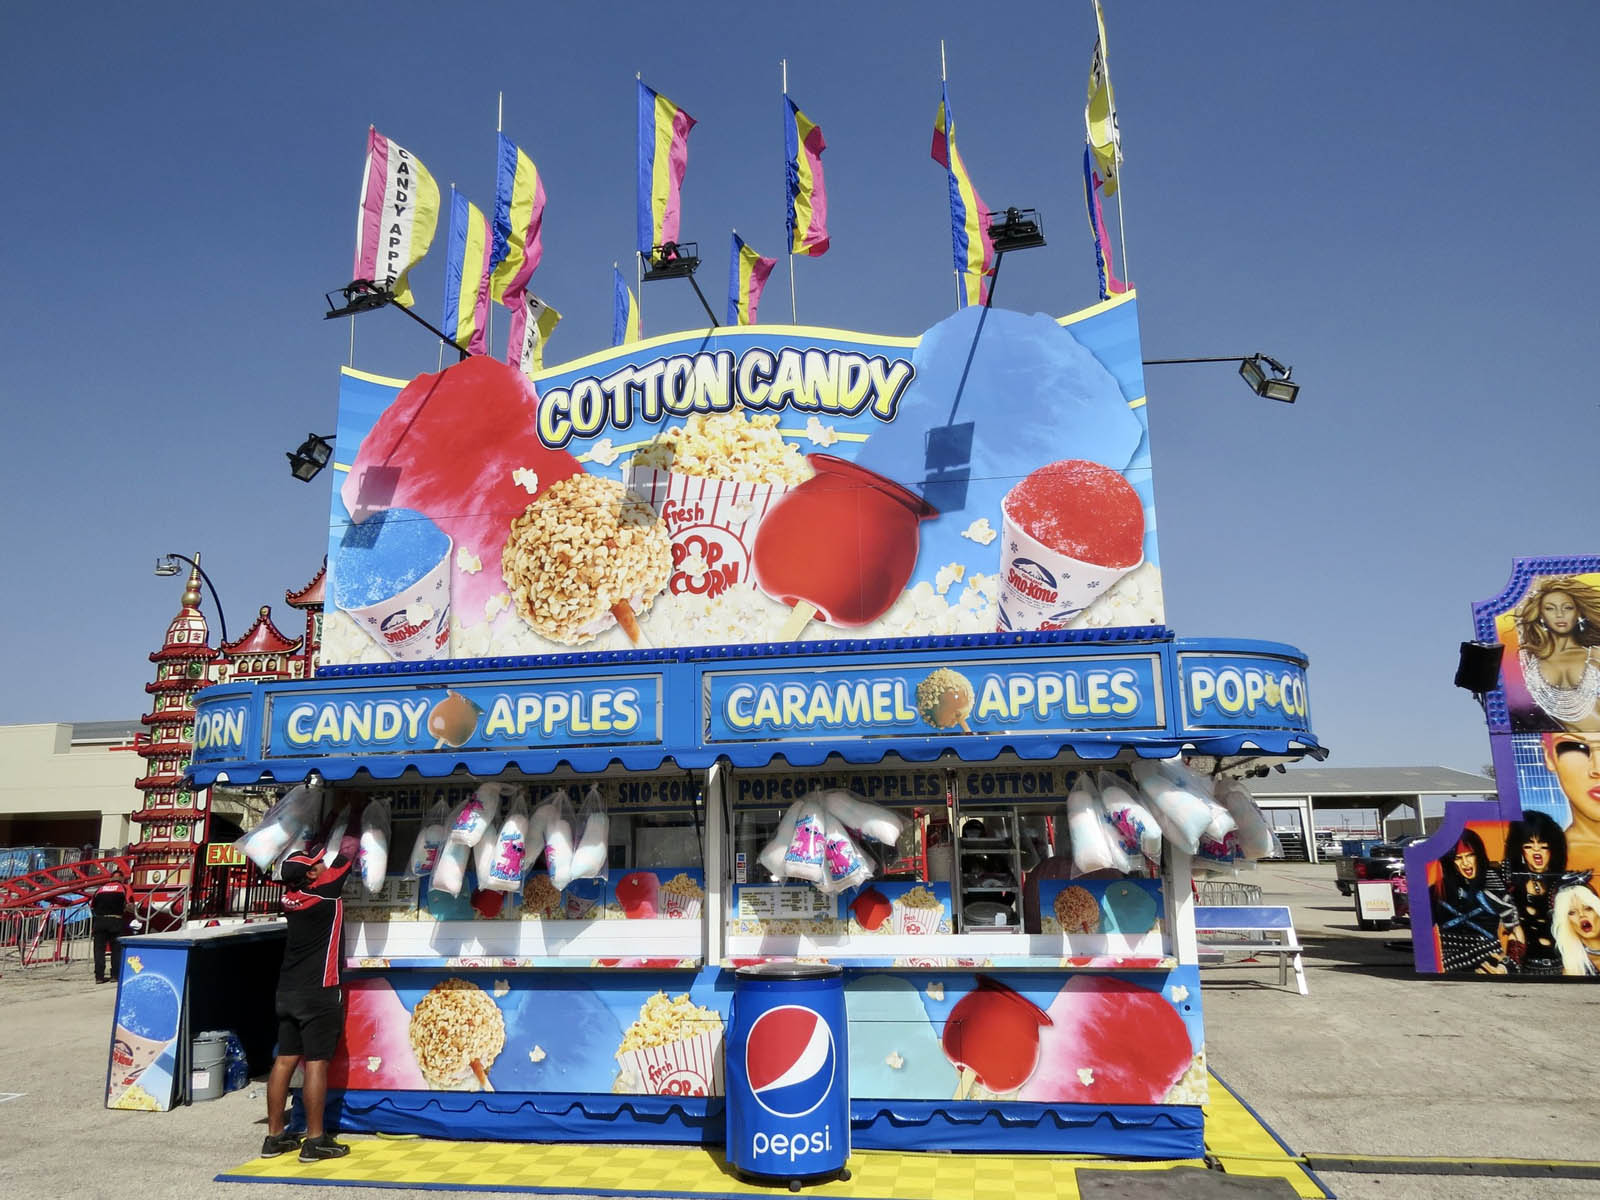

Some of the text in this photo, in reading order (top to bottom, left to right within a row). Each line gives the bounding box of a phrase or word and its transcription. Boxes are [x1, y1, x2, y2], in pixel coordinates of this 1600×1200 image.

[393, 149, 410, 217] CANDY
[537, 349, 911, 446] COTTON CANDY
[662, 500, 704, 533] fresh
[671, 535, 723, 571] POP
[670, 562, 739, 599] CORN
[287, 692, 638, 743] CANDY APPLES
[727, 672, 1138, 727] CARAMEL APPLES
[852, 774, 941, 799] APPLES
[967, 771, 1054, 794] COTTON
[207, 845, 244, 864] EXIT
[753, 1125, 831, 1161] pepsi
